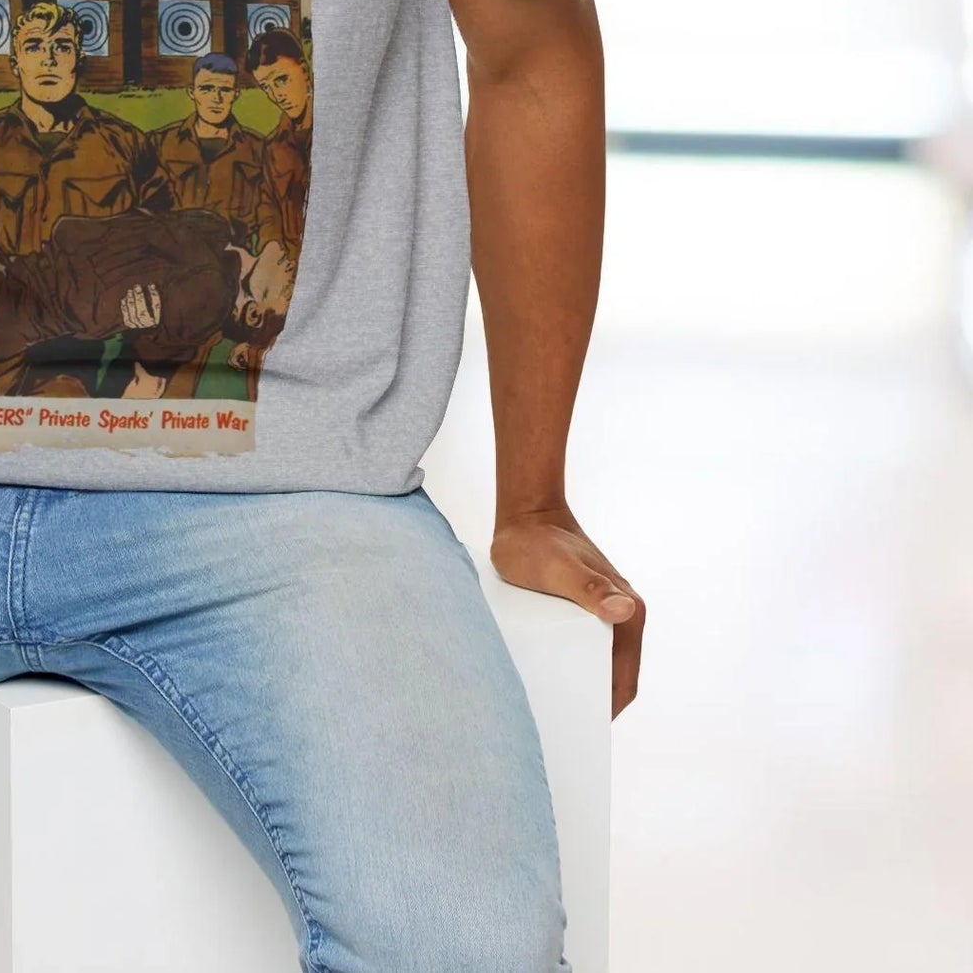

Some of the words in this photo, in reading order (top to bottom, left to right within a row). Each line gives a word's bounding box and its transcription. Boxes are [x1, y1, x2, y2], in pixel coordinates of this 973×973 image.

[39, 408, 91, 428] Private
[162, 411, 210, 429] Private
[217, 411, 249, 431] War
